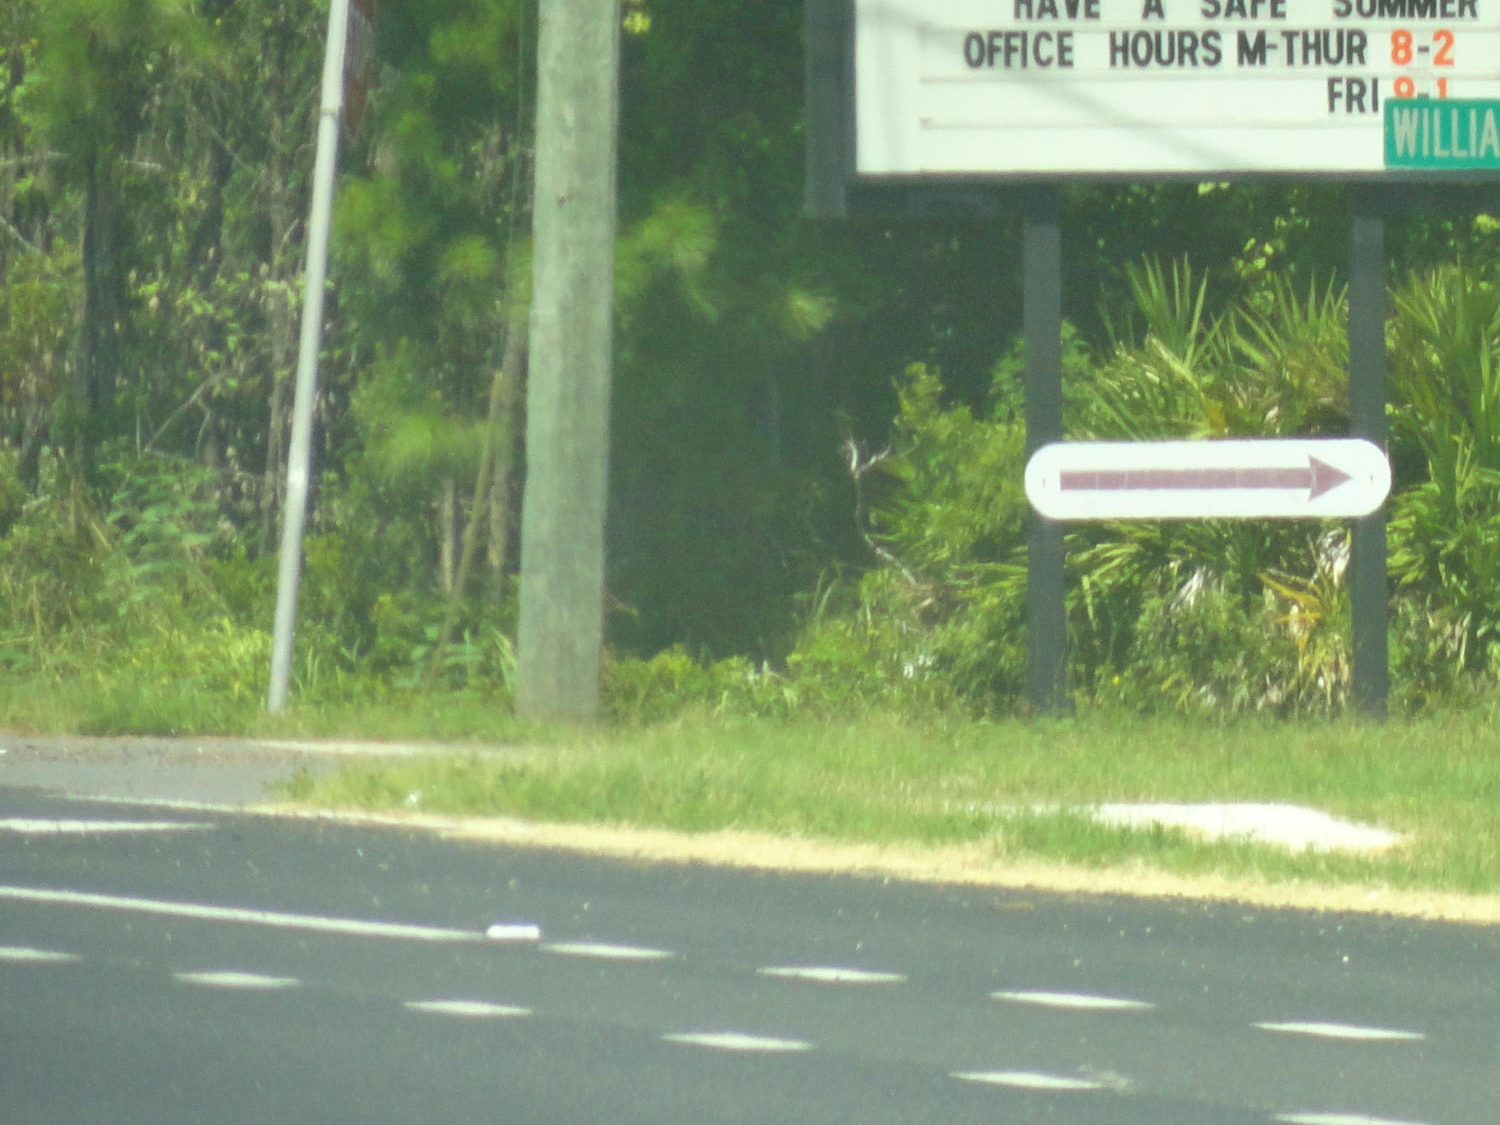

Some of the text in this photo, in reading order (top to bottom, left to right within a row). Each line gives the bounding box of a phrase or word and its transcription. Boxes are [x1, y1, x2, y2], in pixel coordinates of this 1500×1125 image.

[963, 28, 1455, 68] OFFICE HOURS M-THUR 8-2
[1327, 76, 1379, 113] FRI
